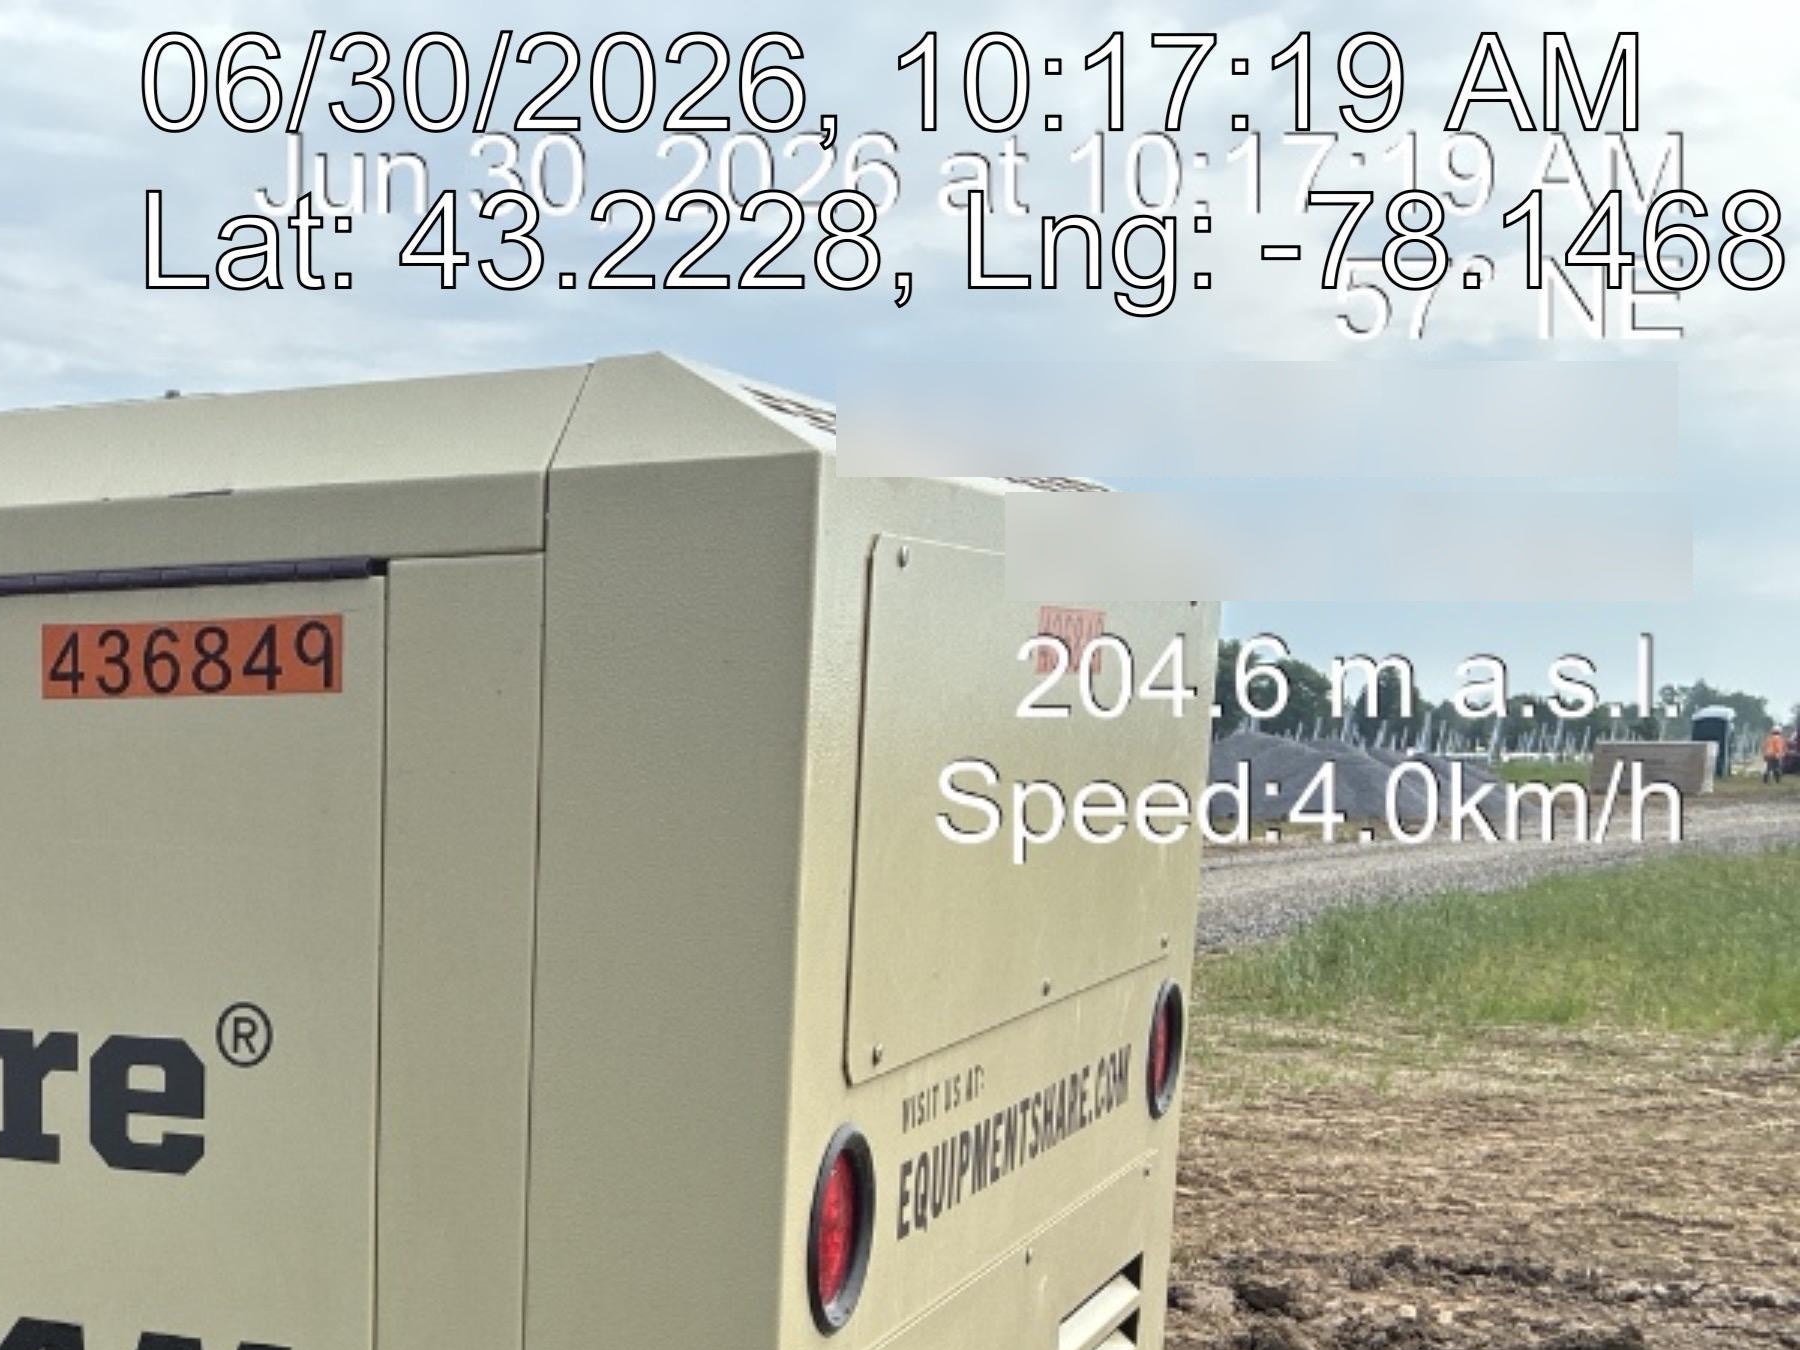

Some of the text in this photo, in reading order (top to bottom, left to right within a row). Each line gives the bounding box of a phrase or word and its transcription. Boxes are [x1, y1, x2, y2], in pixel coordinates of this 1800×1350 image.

[48, 619, 335, 697] 436849
[896, 1043, 1132, 1241] EQUIPMENTSHARE.COM
[901, 1083, 940, 1134] VISIT
[944, 1073, 961, 1113] US
